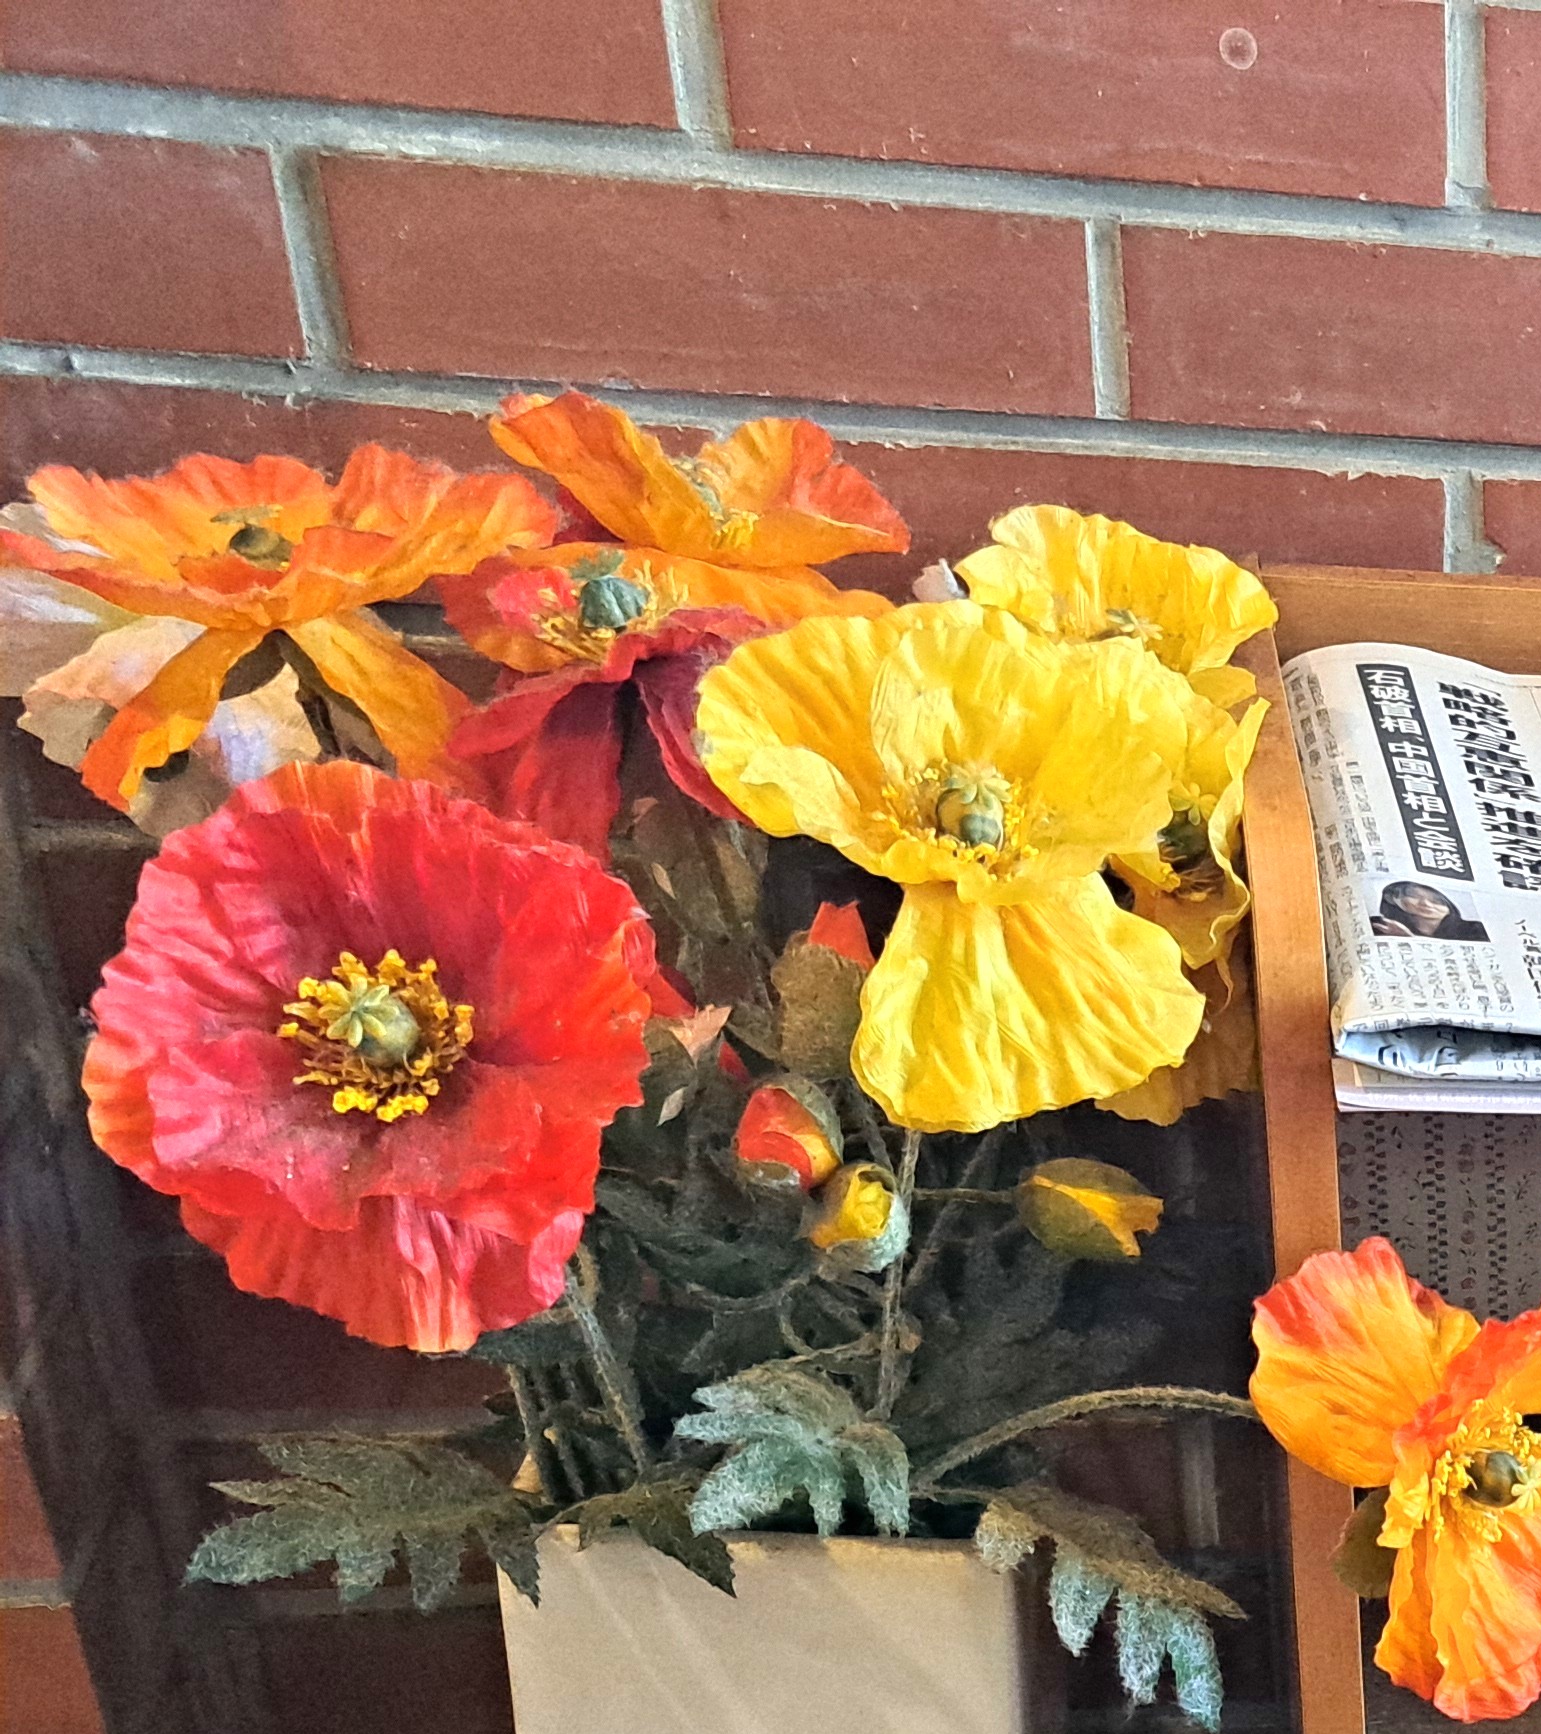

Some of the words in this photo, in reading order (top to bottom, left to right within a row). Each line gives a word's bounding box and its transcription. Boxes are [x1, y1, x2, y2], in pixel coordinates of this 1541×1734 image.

[1363, 668, 1466, 874] 石破首相、中国首相と会談
